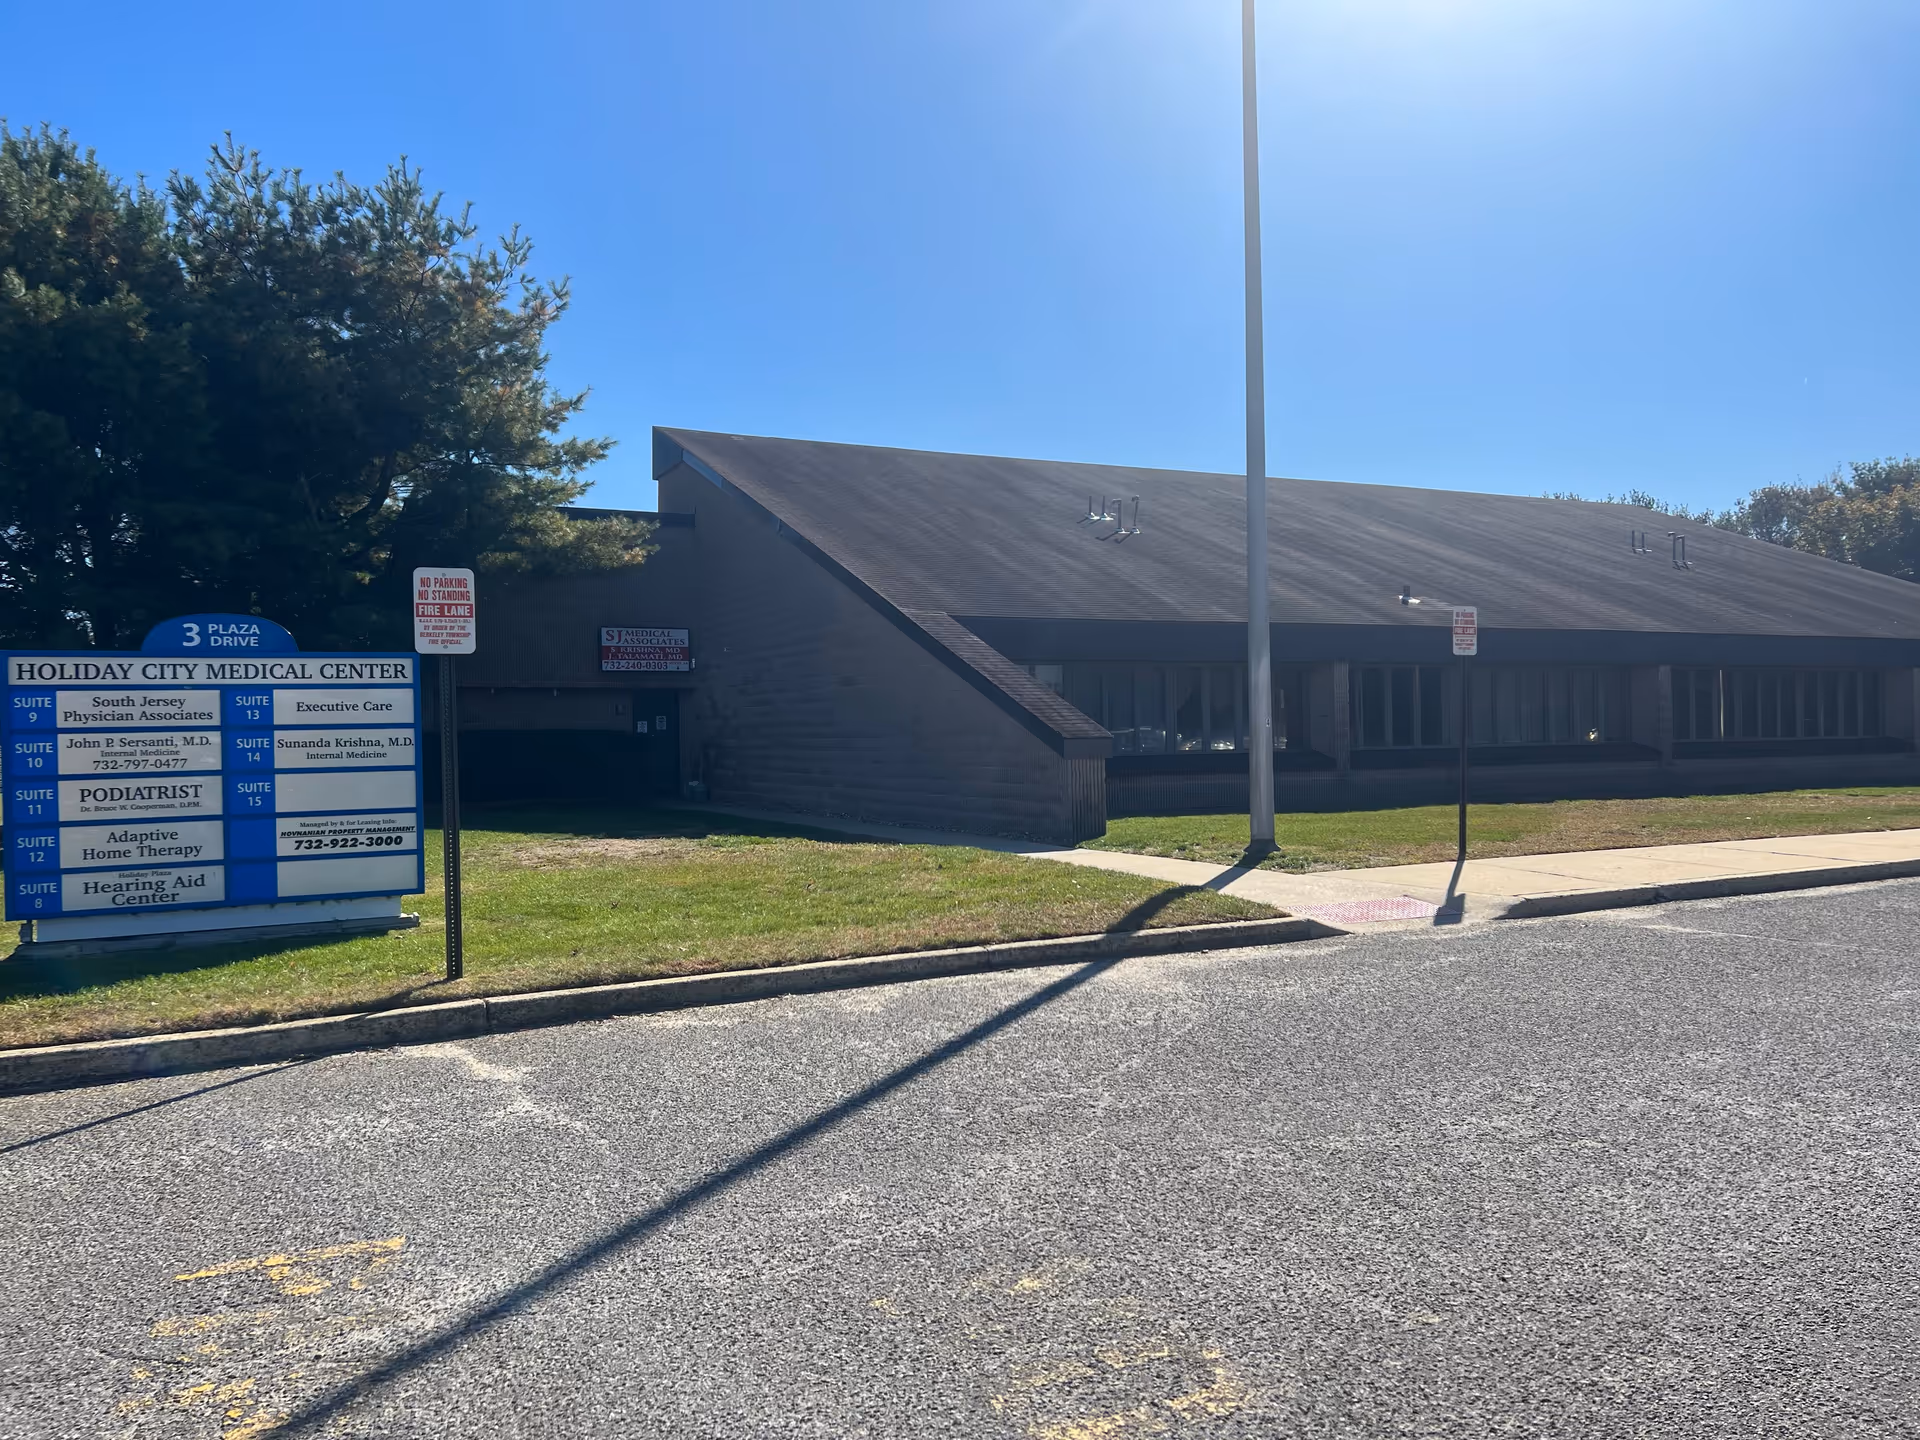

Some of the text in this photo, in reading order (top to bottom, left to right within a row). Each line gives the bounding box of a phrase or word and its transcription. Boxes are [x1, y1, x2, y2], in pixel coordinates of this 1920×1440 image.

[420, 577, 468, 588] NO PARKING
[418, 590, 470, 601] NO STANDING
[418, 605, 470, 616] FIRE LANE
[182, 623, 201, 646] 3
[208, 624, 260, 634] PLAZA
[210, 636, 260, 646] DRIVE
[622, 638, 685, 646] ASSOCIATES
[16, 663, 408, 680] HOLIDAY CITY MEDICAL CENTER
[14, 698, 52, 708] SUITE
[92, 696, 186, 710] South Jersey
[236, 696, 270, 706] SUITE
[296, 700, 393, 712] Executive Care
[28, 712, 38, 722] 9
[63, 710, 214, 725] Physician Associates
[246, 710, 260, 720] 13
[15, 742, 54, 754] SUITE
[66, 736, 212, 749] John P. Sersanti, M.D.
[236, 738, 270, 749] SUITE
[277, 736, 415, 749] Sunanda Krishna, M.D.
[246, 752, 260, 762] 14
[306, 751, 388, 760] Internal Medicine
[26, 758, 43, 768] 10
[92, 758, 188, 770] 732-797-0477
[237, 782, 272, 793] SUITE
[16, 789, 54, 800] SUITE
[79, 784, 203, 803] PODIATRIST
[130, 802, 178, 811] Cooperman,
[179, 801, 203, 809] D.P.M.
[248, 796, 262, 806] 15
[28, 804, 42, 815] 11
[17, 836, 56, 848] SUITE
[106, 829, 179, 845] Adaptive
[294, 836, 404, 850] 732-922-3000
[28, 852, 44, 862] 12
[82, 845, 204, 861] Home Therapy
[118, 871, 149, 879] Holiday
[19, 883, 58, 895] SUITE
[83, 874, 206, 893] Hearing Aid
[34, 898, 43, 909] 8
[112, 892, 180, 906] Center
